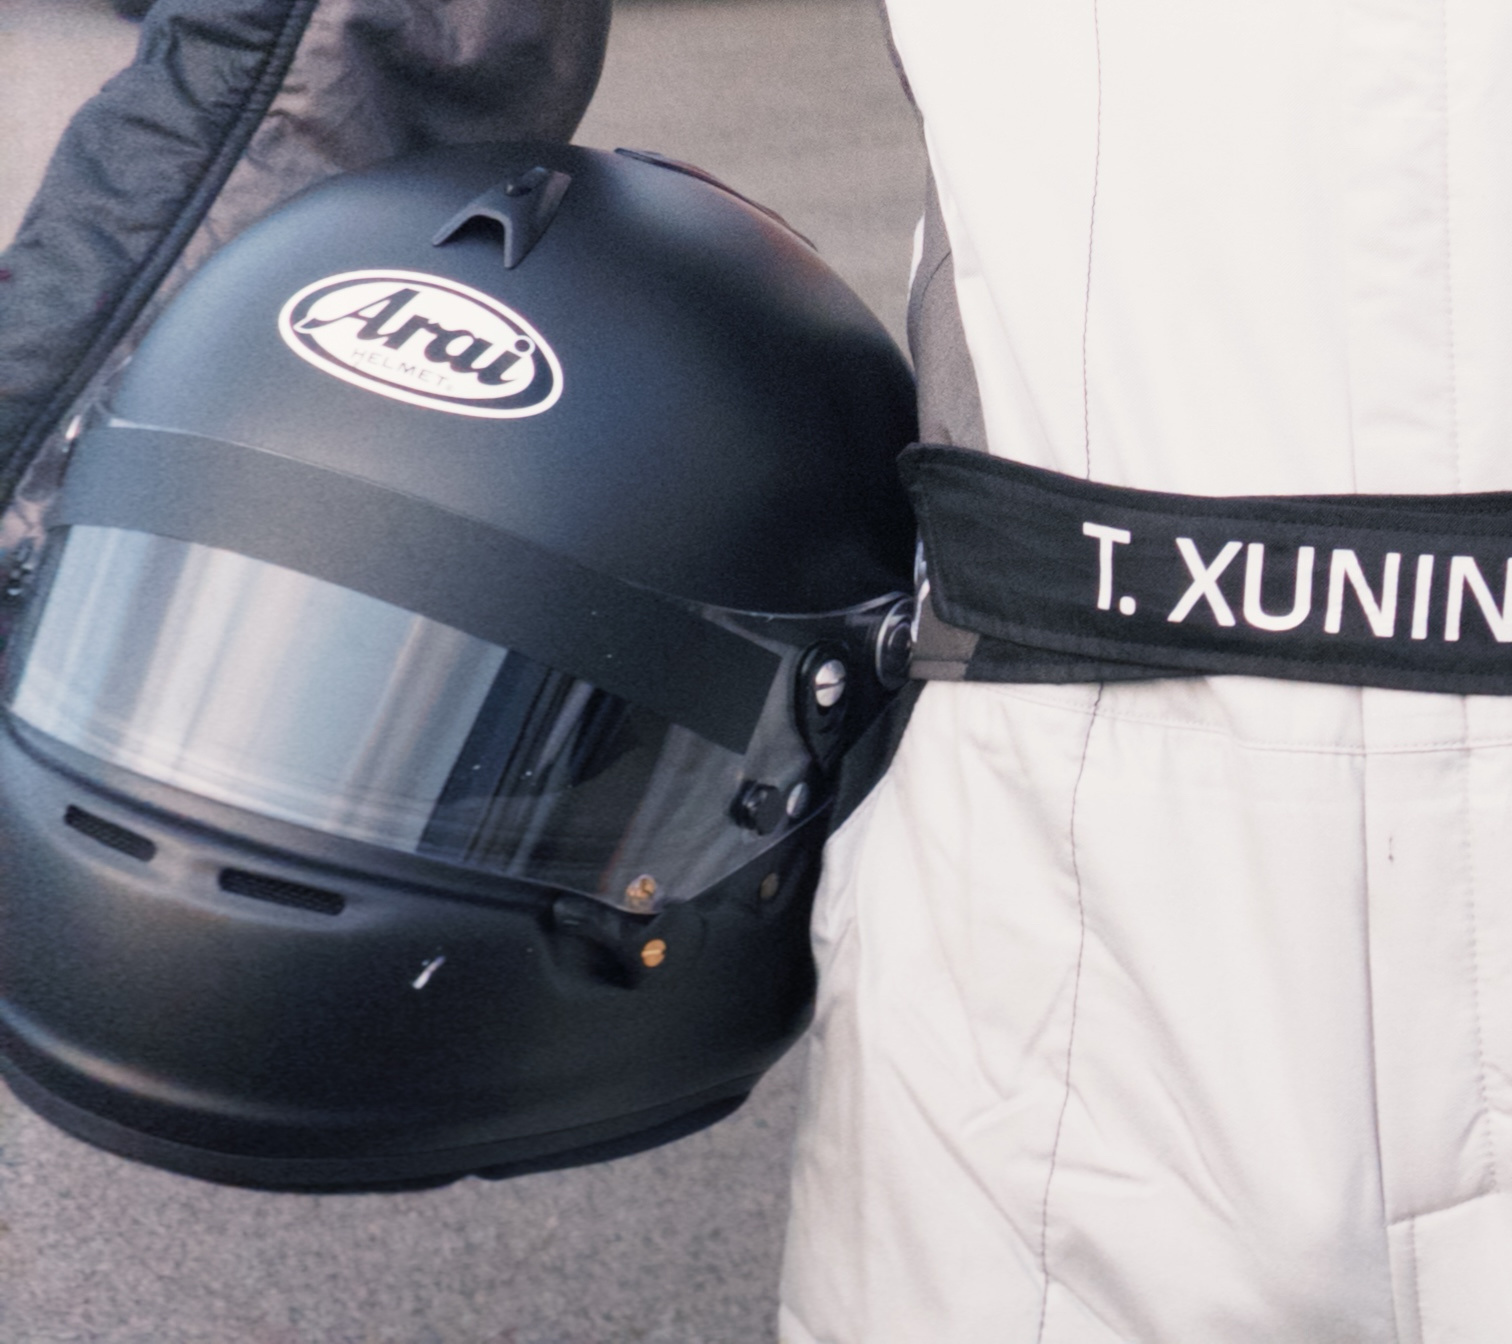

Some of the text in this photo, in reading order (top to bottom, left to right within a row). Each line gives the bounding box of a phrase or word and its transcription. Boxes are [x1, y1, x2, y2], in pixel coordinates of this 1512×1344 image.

[299, 287, 531, 386] Arai
[350, 348, 448, 387] HELMET
[1082, 521, 1136, 616] T.
